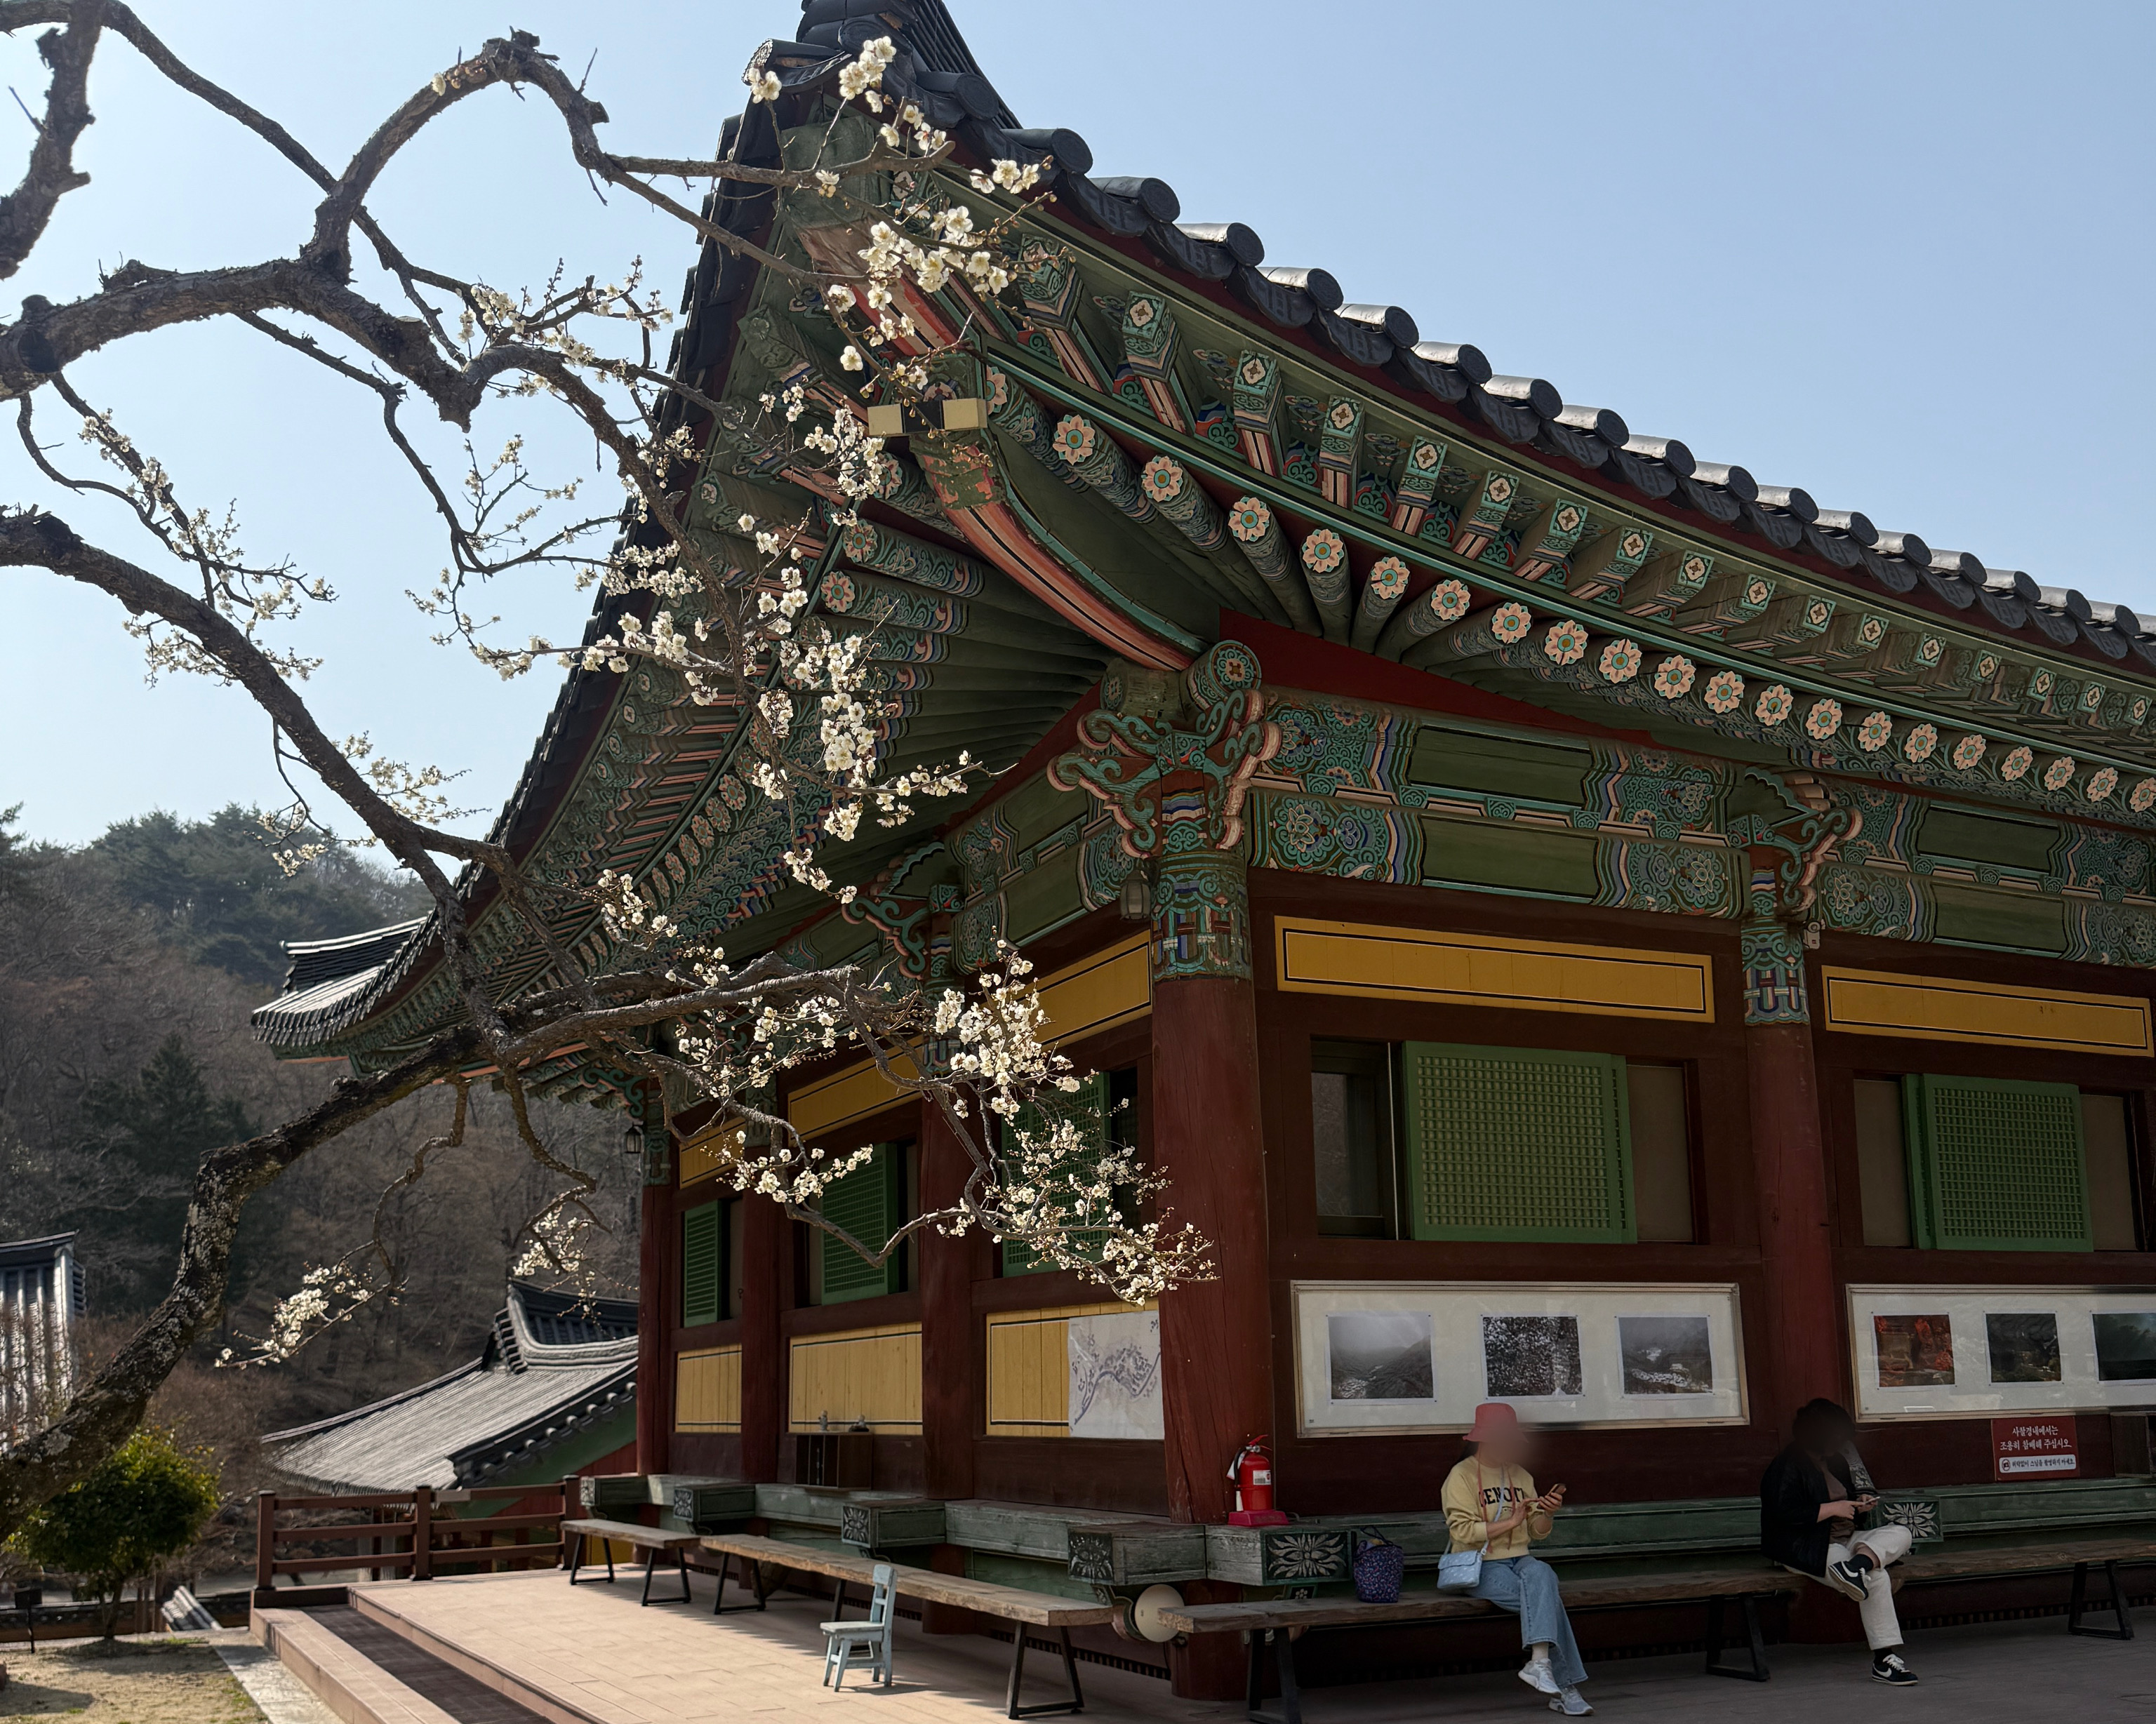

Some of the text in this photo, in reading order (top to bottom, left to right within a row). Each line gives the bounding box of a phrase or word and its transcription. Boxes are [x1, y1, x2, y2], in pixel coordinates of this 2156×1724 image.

[2012, 1425, 2058, 1437] 사찰경내에서는
[1999, 1440, 2020, 1451] 조용히
[2044, 1438, 2072, 1450] 주십시오
